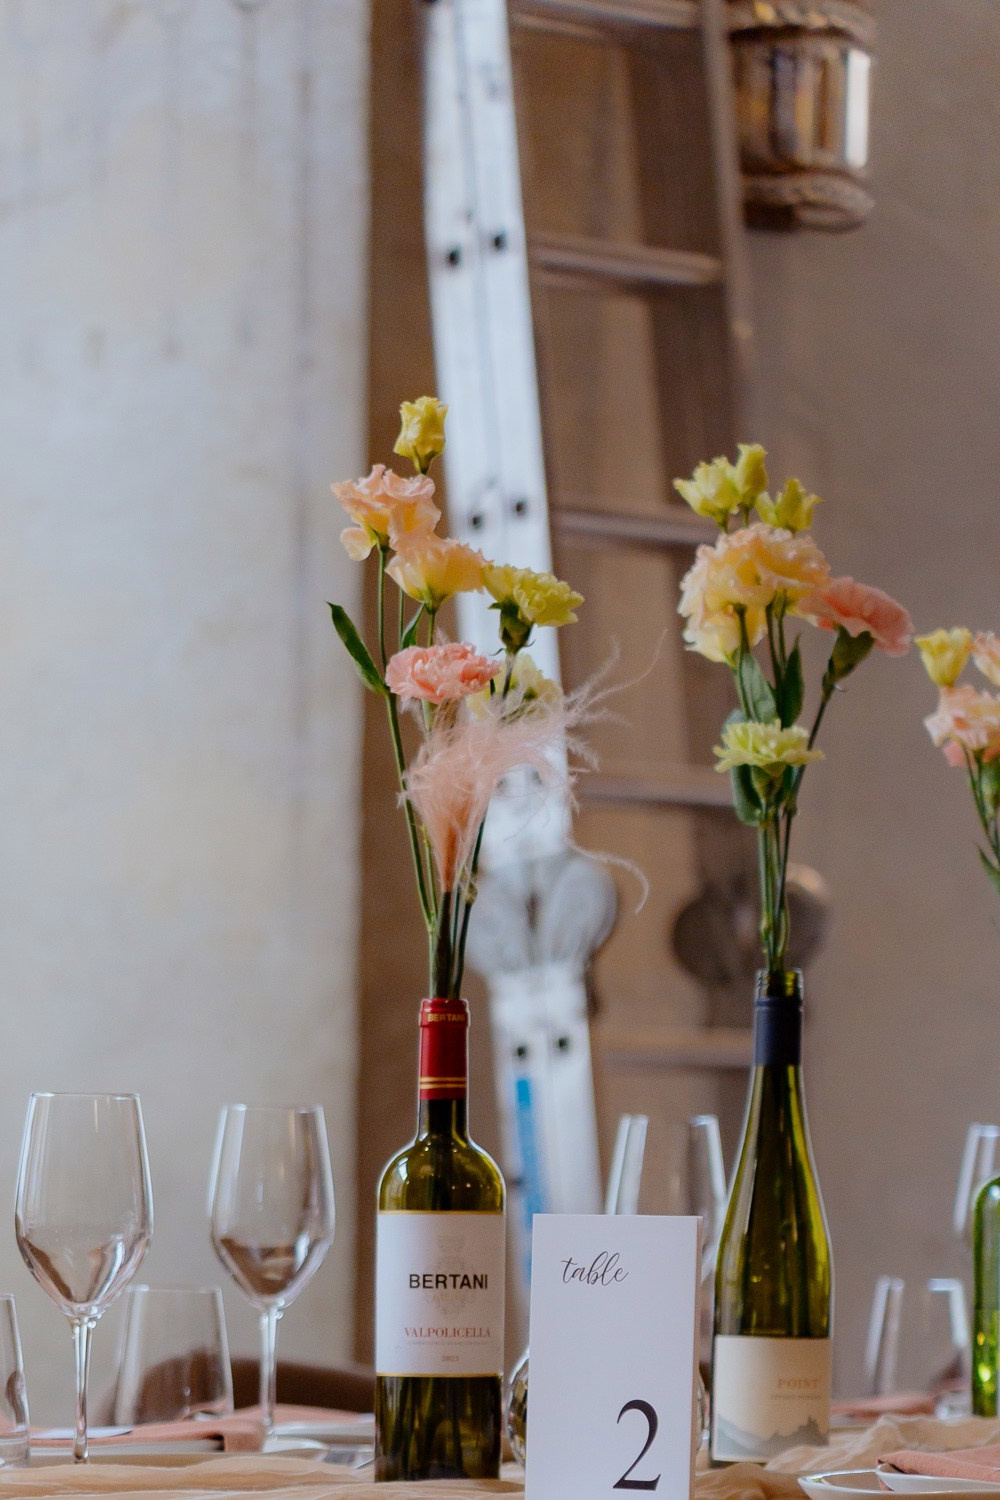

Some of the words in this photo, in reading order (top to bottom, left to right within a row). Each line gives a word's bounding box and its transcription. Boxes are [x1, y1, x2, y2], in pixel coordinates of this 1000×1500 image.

[409, 1273, 489, 1290] BERTANI
[560, 1250, 629, 1287] table
[404, 1327, 491, 1338] VALPOLICELLA
[612, 1398, 662, 1492] 2
